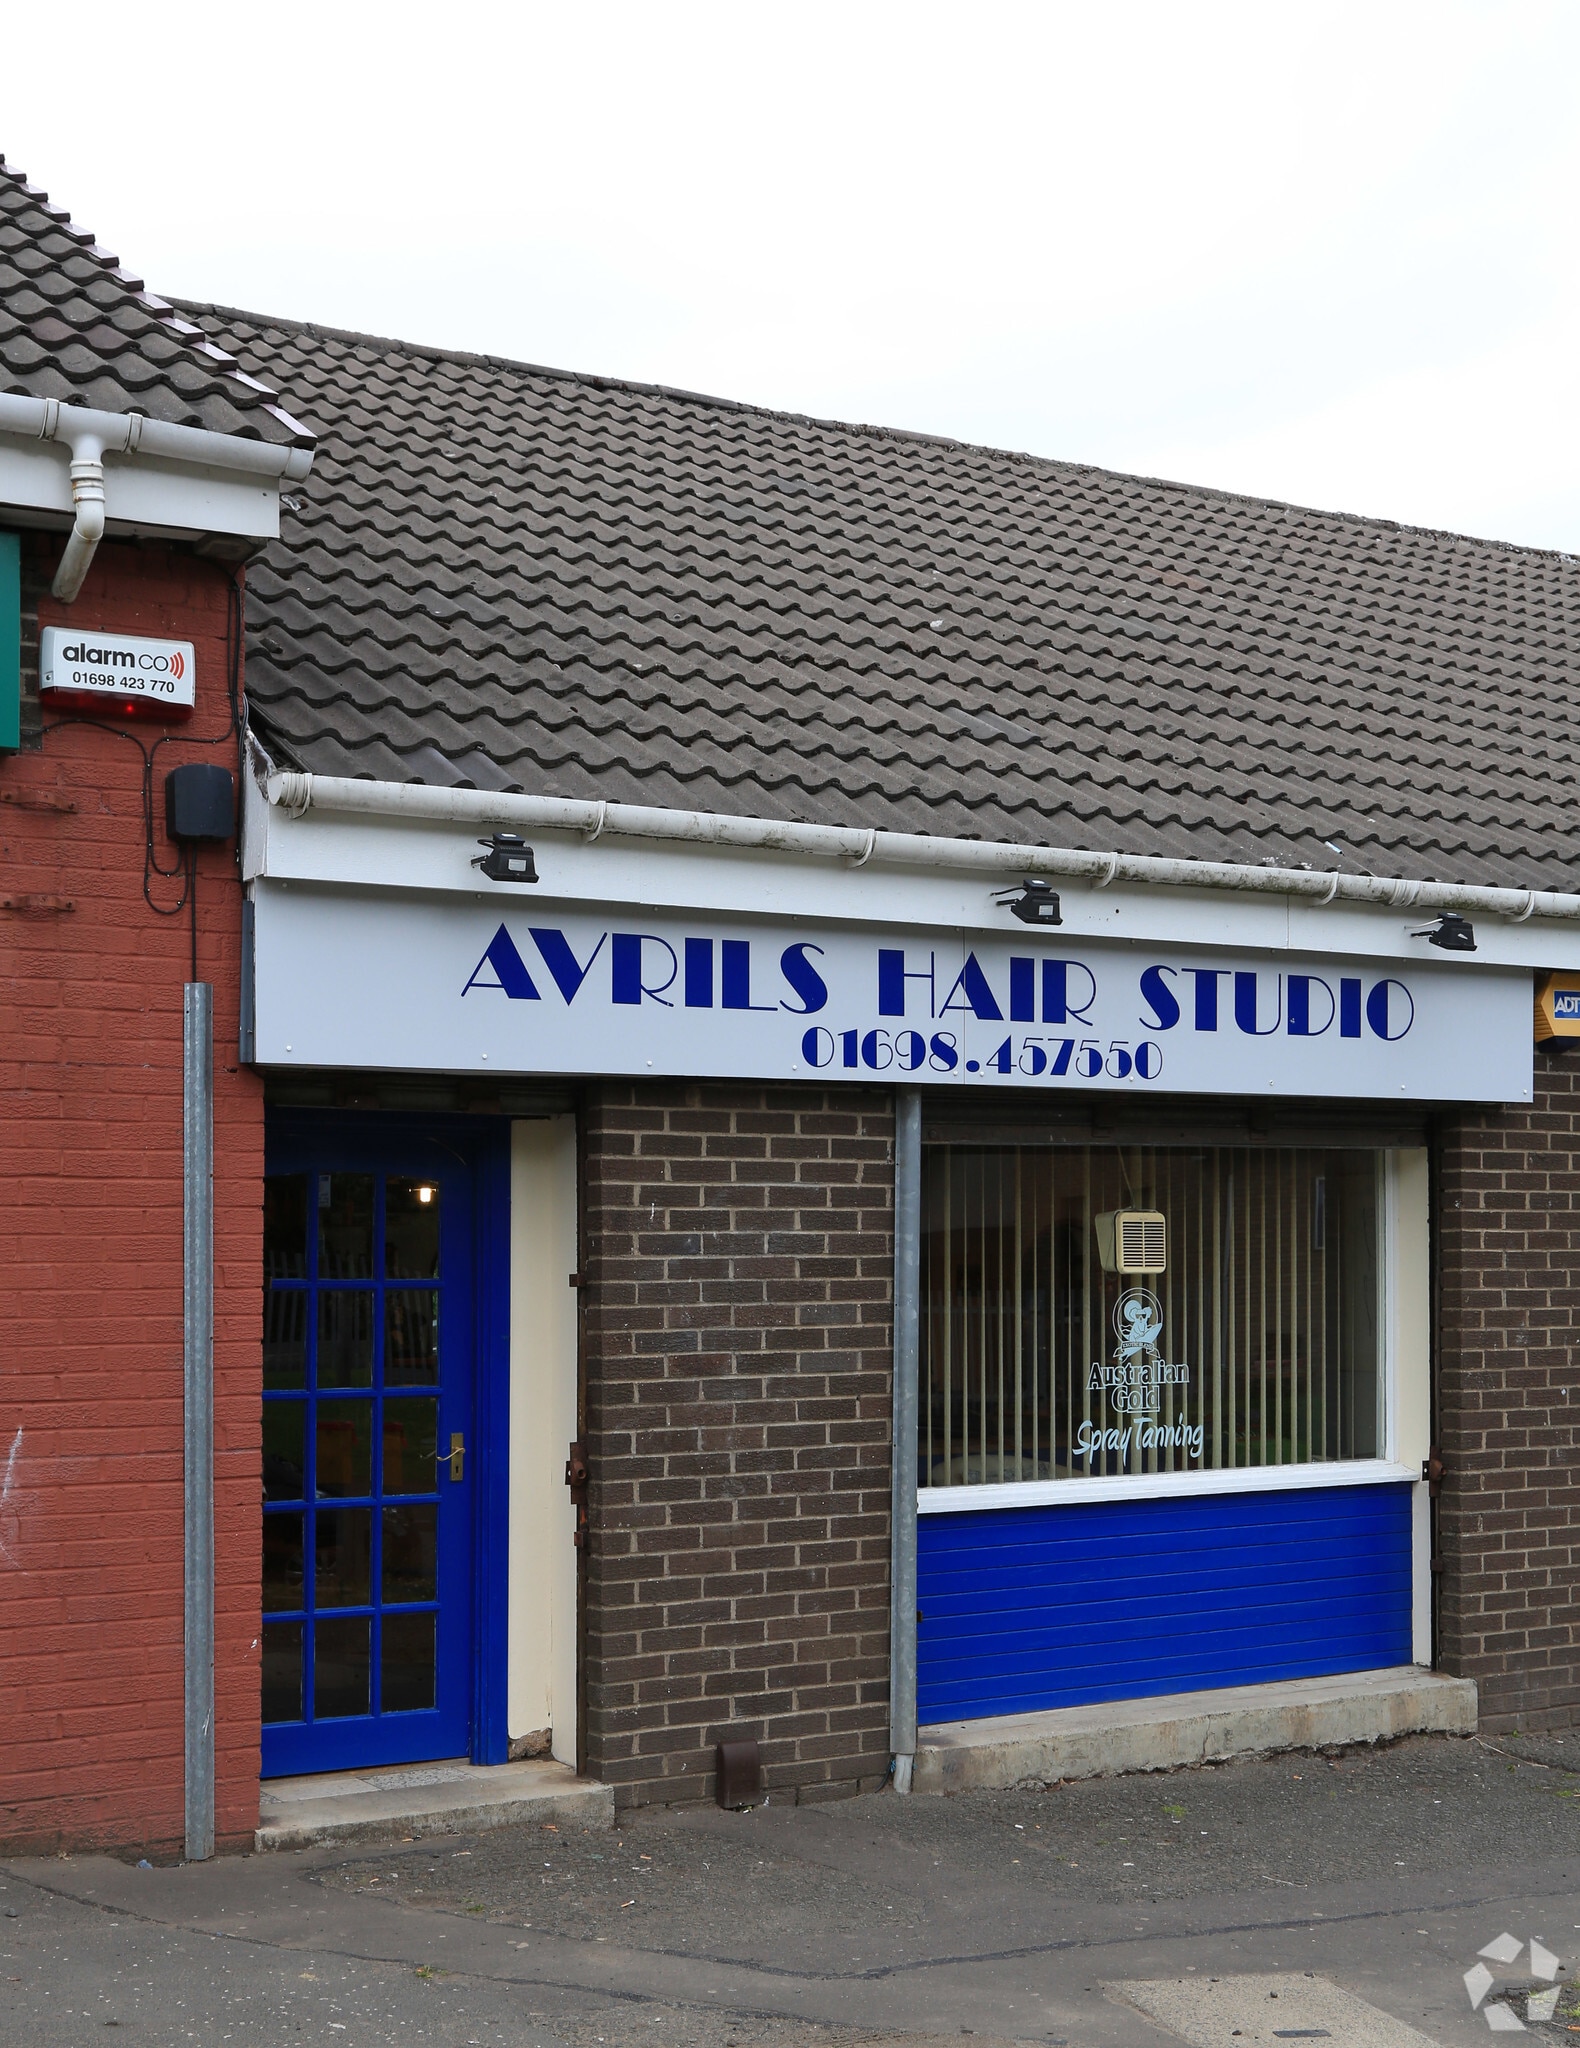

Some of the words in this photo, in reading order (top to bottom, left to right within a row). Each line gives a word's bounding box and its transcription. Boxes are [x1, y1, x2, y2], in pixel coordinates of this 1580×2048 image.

[72, 671, 115, 687] 01698
[119, 676, 145, 690] 423
[150, 679, 175, 693] 770
[461, 922, 829, 1015] AVRILS
[878, 949, 1097, 1027] HAIR
[1139, 965, 1415, 1042] STUDIO
[1555, 996, 1580, 1013] ADT
[801, 1026, 1163, 1080] 01698.457550
[1085, 1359, 1190, 1390] Australian
[1111, 1385, 1161, 1413] Gold
[1071, 1419, 1132, 1466] Spray
[1133, 1412, 1204, 1458] Tanning
